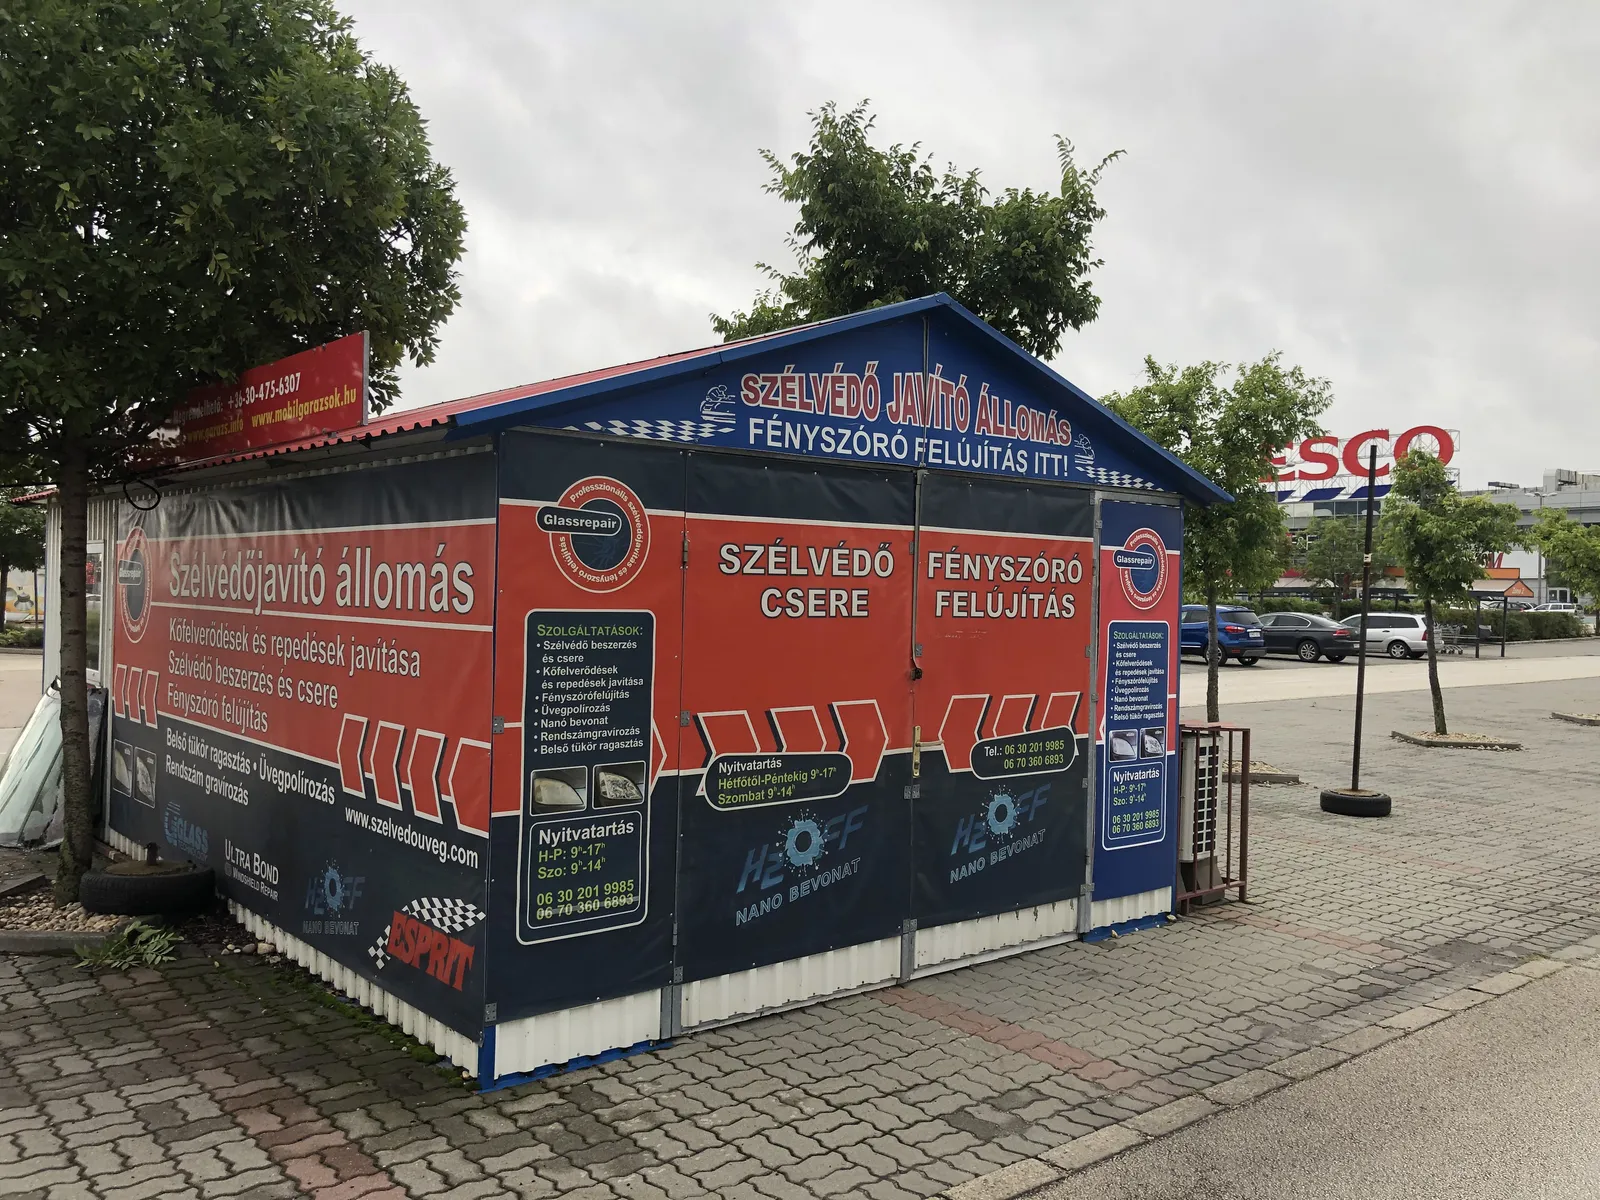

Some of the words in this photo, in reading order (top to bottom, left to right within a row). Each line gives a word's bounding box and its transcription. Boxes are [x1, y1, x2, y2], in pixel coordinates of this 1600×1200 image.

[228, 372, 301, 409] +36-30-475-6307
[251, 385, 357, 428] www.mobilgarazsok.hu
[741, 360, 880, 422] SZÉLVÉDŐ
[886, 363, 970, 433] JAVÍTÓ
[974, 382, 1072, 446] ÁLLOMÁS
[750, 414, 908, 460] FÉNYSZÓRÓ
[915, 437, 1028, 473] FELÚJÍTÁS
[1034, 452, 1068, 476] ITT!
[1259, 426, 1454, 482] ESCO
[570, 482, 628, 503] Professzionális
[544, 514, 616, 530] Glassrepair
[627, 502, 643, 568] szélvédőjavítás
[559, 536, 577, 573] felújítás
[719, 538, 894, 578] SZÉLVÉDŐ
[1117, 556, 1152, 565] Glassrepair
[618, 566, 628, 576] és
[928, 546, 1082, 584] FÉNYSZÓRÓ
[169, 547, 326, 615] Szélvédőjavító
[335, 542, 474, 614] állomás
[578, 569, 618, 582] fényszóró
[760, 588, 869, 618] CSERE
[935, 586, 1075, 619] FELÚJÍTÁS
[537, 624, 643, 636] SZOLGÁLTATÁSOK:
[169, 617, 249, 652] Kőfelverődések
[252, 630, 267, 655] és
[271, 632, 345, 666] repedések
[349, 638, 421, 677] javítása
[544, 640, 588, 650] Szélvédő
[591, 640, 637, 649] beszerzés
[542, 654, 553, 663] és
[168, 649, 212, 682] Szélvédő
[215, 664, 273, 695] beszerzés
[278, 672, 293, 700] és
[298, 681, 338, 709] csere
[543, 666, 618, 676] Kőfelverődések
[542, 680, 553, 689] és
[556, 678, 606, 690] repedések
[608, 677, 644, 688] javítása
[542, 690, 630, 703] Fényszórófelújítás
[168, 683, 218, 718] Fényszóró
[221, 699, 268, 734] felújítás
[542, 704, 610, 716] Üvegpolírozás
[541, 718, 567, 728] Nanó
[570, 716, 608, 726] bevonat
[541, 727, 640, 741] Rendszámgravírozás
[540, 743, 568, 754] Belső
[572, 742, 596, 752] tükör
[599, 739, 643, 751] ragasztás
[984, 746, 1002, 757] Tel.:
[1005, 744, 1014, 755] 06
[1017, 743, 1027, 753] 30
[1029, 742, 1042, 753] 201
[1046, 740, 1064, 751] 9985
[167, 728, 187, 751] Belső
[188, 736, 209, 759] tükör
[210, 747, 251, 775] ragasztás
[259, 753, 335, 804] Üvegpolírozás
[719, 758, 782, 775] Nyitvatartás
[1004, 758, 1014, 769] 06
[1016, 757, 1026, 768] 70
[1029, 756, 1042, 766] 360
[1045, 754, 1063, 765] 6893
[166, 755, 204, 787] Rendszám
[206, 774, 249, 806] gravírozás
[718, 770, 808, 790] Hétfőtől-Péntekig
[1114, 768, 1160, 784] Nyitvatartás
[718, 788, 765, 805] Szombat
[1114, 786, 1128, 794] H-P:
[1113, 798, 1128, 806] Szo:
[1112, 815, 1120, 824] 06
[1123, 814, 1130, 822] 30
[1132, 812, 1143, 821] 201
[1145, 810, 1159, 819] 9985
[1112, 825, 1120, 834] 06
[1123, 824, 1130, 832] 70
[1132, 822, 1143, 831] 360
[1145, 819, 1159, 828] 6893
[345, 806, 479, 869] www.szelvedouveg.com
[539, 820, 634, 847] Nyitvatartás
[225, 838, 251, 871] ULTRA
[254, 853, 278, 884] BOND
[538, 849, 566, 862] H-P:
[950, 857, 985, 883] NANO
[990, 829, 1046, 866] BEVONAT
[538, 868, 566, 879] Szo:
[232, 867, 260, 890] WINDSHIELD
[260, 882, 278, 901] REPAIR
[537, 892, 553, 906] 06
[558, 889, 572, 902] 30
[578, 885, 599, 900] 201
[604, 880, 634, 895] 9985
[736, 893, 782, 925] NANO
[789, 857, 860, 902] BEVONAT
[536, 908, 553, 920] 06
[558, 904, 572, 917] 70
[577, 900, 600, 913] 360
[604, 894, 634, 909] 6893
[303, 921, 322, 934] NANO
[324, 921, 359, 935] BEVONAT
[386, 910, 475, 992] ESPRIT
